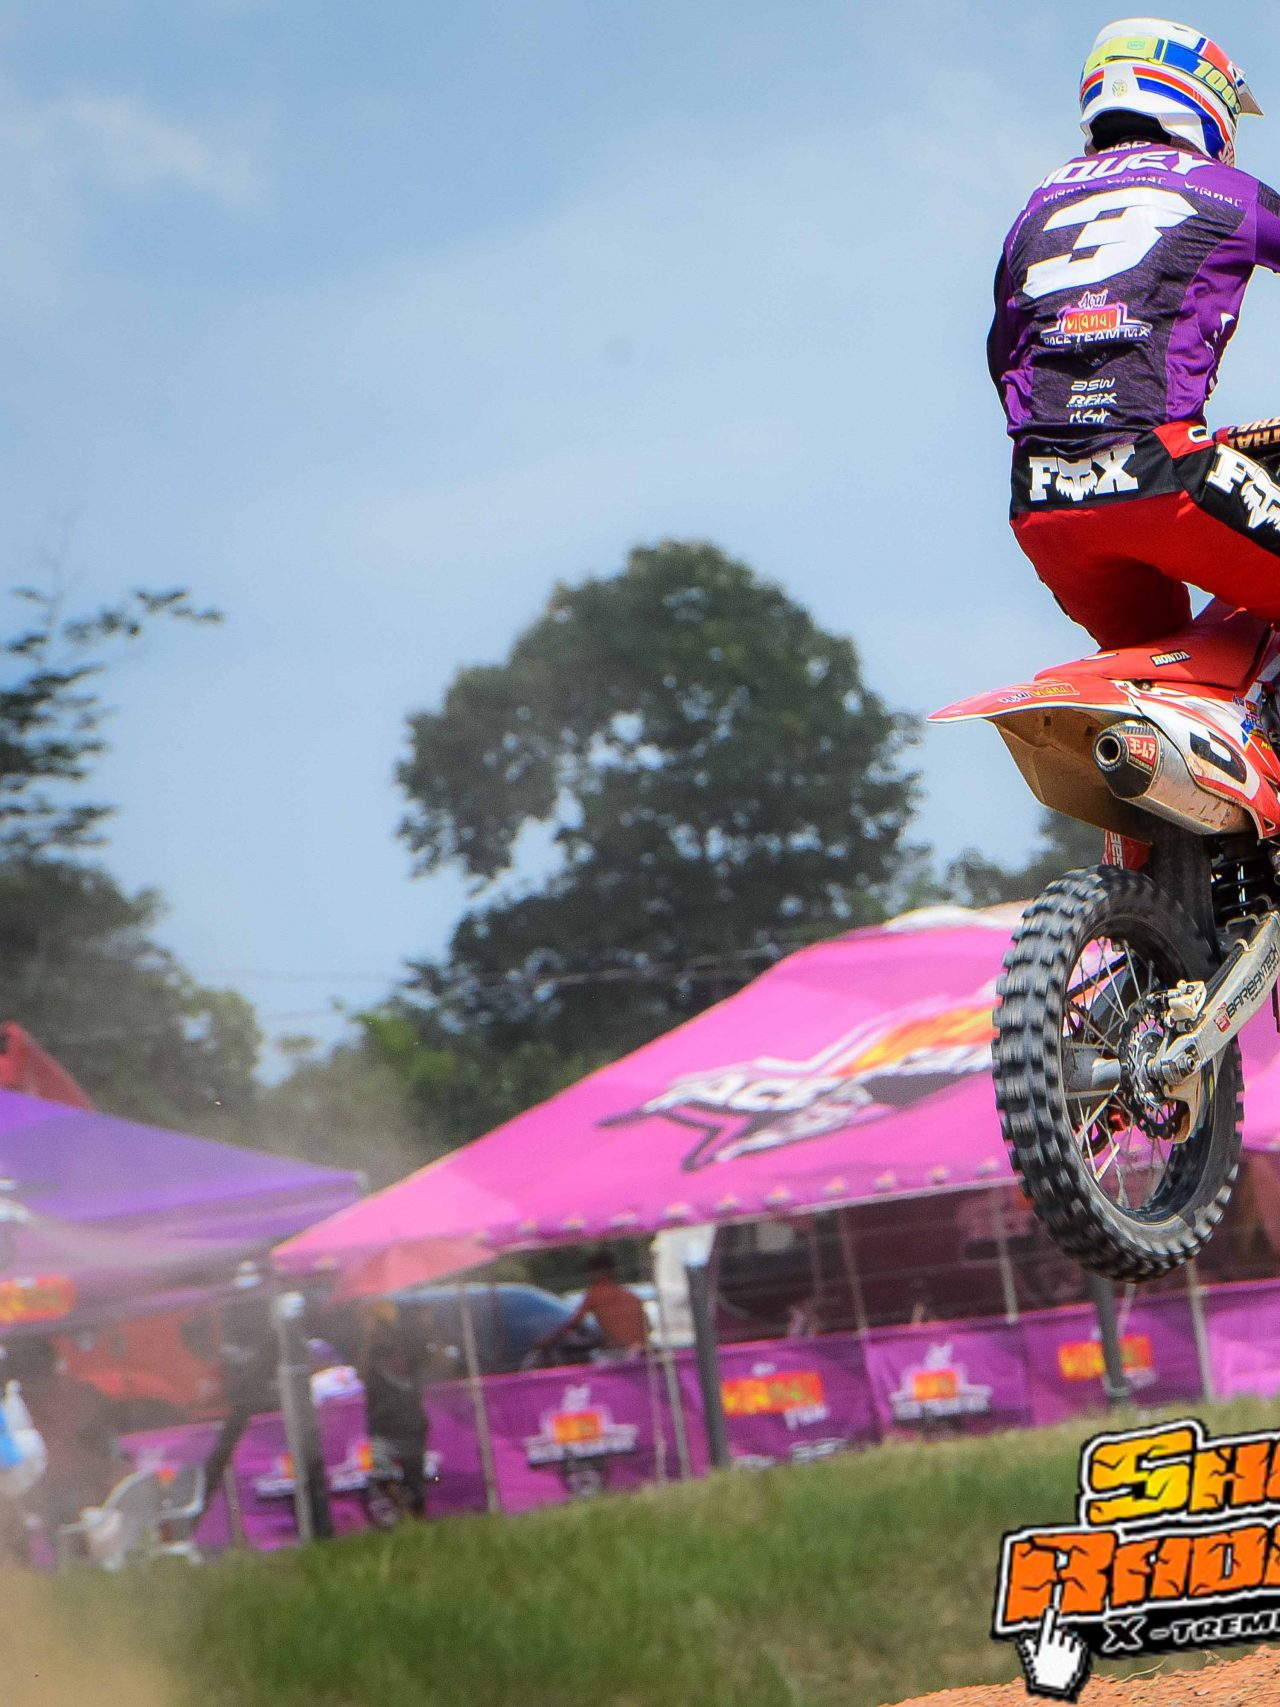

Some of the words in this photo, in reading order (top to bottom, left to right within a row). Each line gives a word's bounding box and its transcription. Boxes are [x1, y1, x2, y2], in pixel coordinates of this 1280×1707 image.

[1193, 58, 1241, 114] 100
[1022, 187, 1199, 299] 3
[1076, 329, 1120, 343] TEAM
[1124, 326, 1149, 338] MX
[1029, 444, 1139, 501] FOX
[1151, 651, 1190, 666] HONDA
